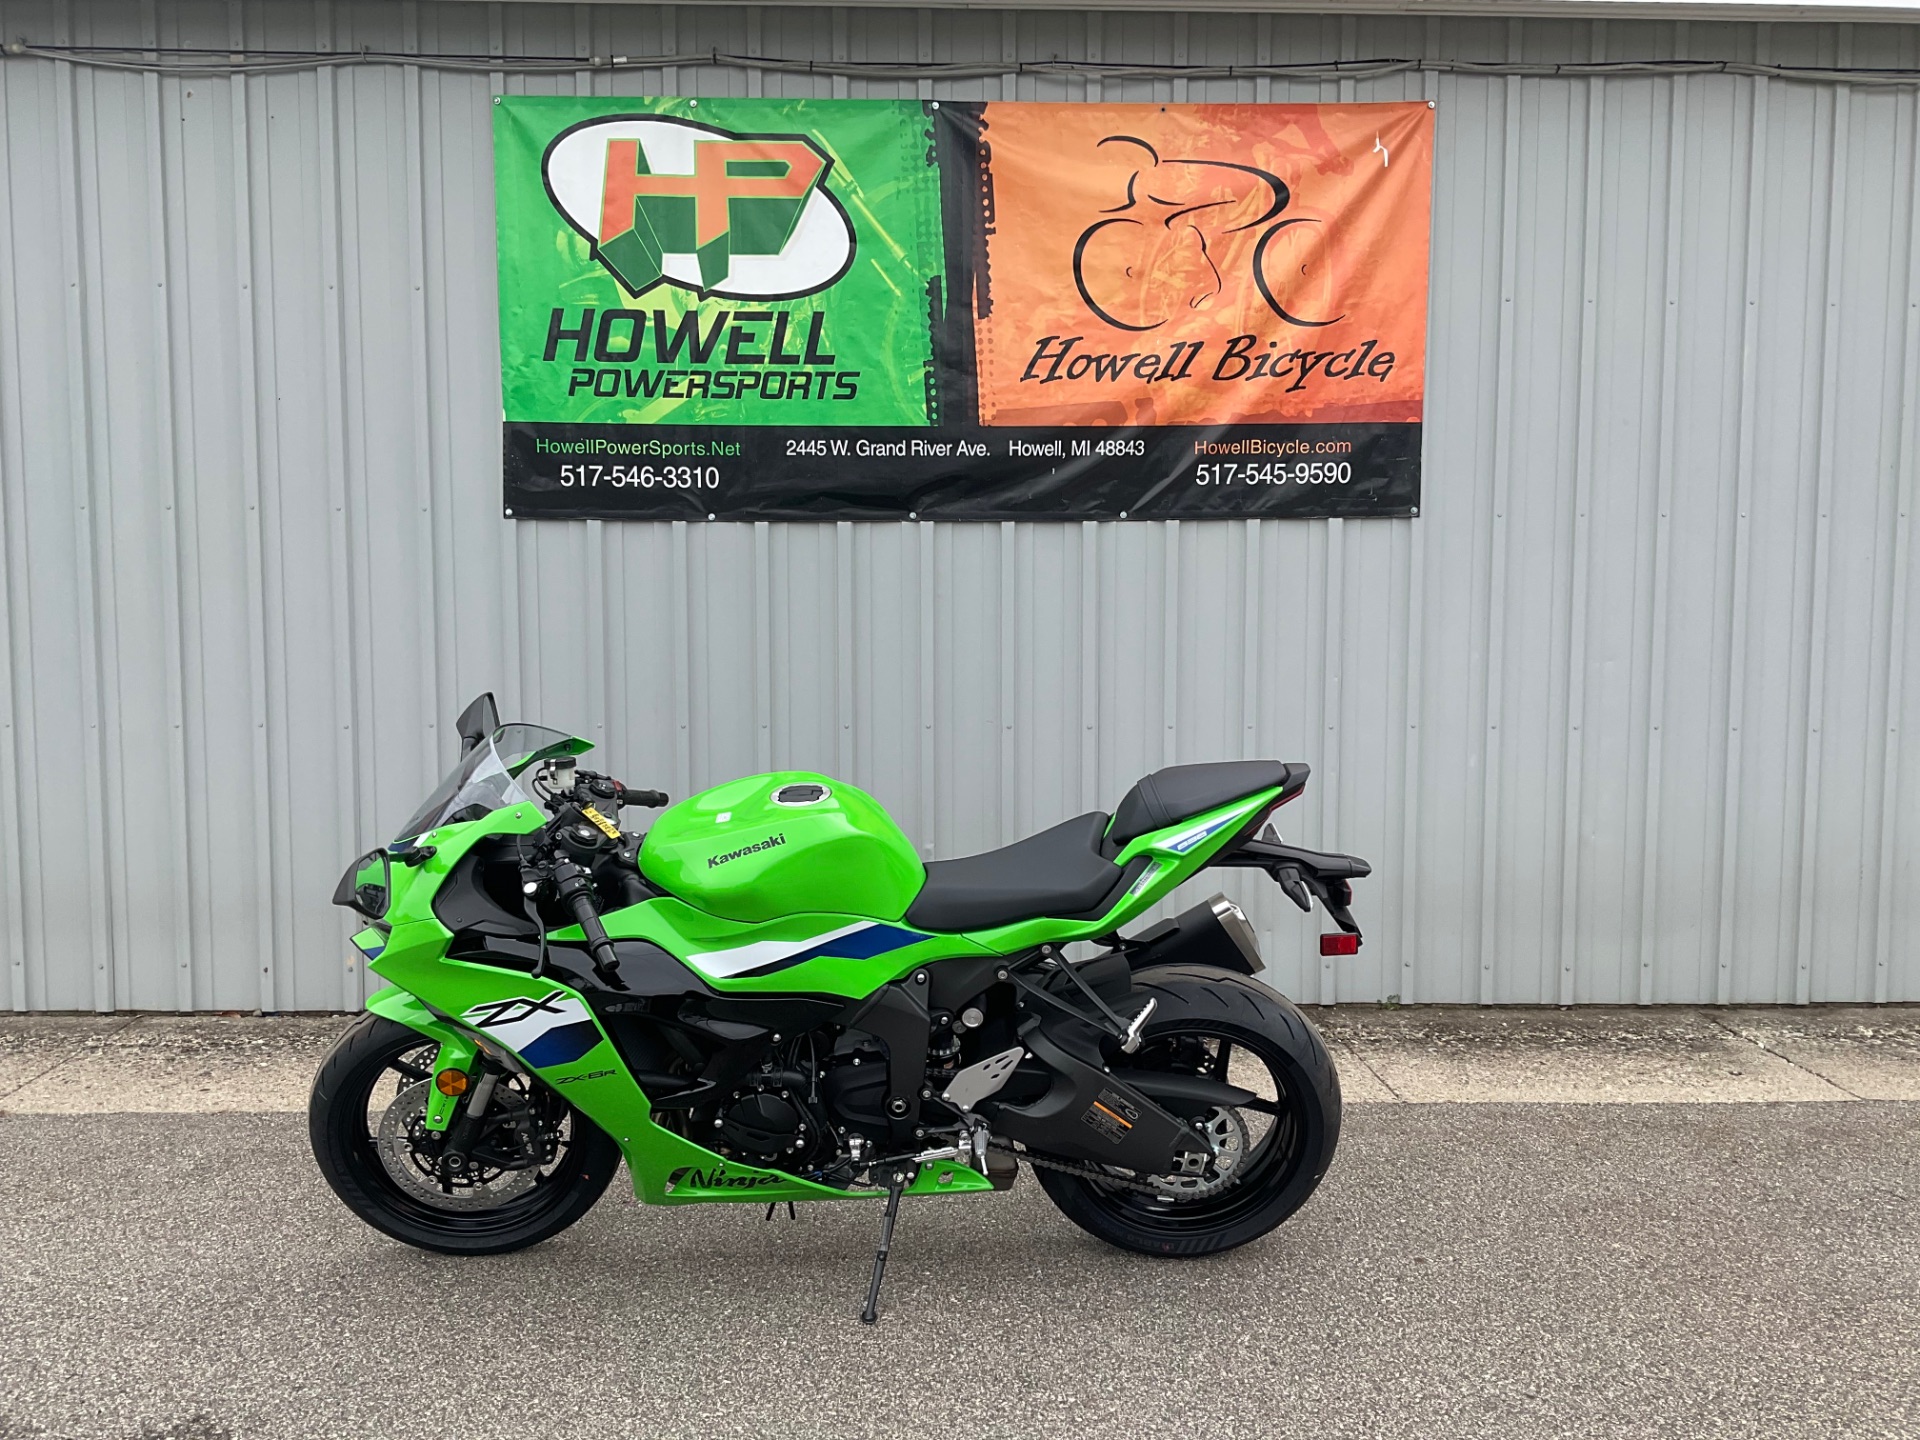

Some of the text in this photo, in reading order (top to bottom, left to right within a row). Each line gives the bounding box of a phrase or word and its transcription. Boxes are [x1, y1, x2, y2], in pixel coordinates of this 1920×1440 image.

[597, 138, 826, 250] HP
[542, 307, 836, 365] HOWELL
[1020, 334, 1396, 393] Howell Bicycle
[568, 368, 861, 400] POWERSPORTS
[535, 438, 741, 459] HowellPowerSports.Net
[786, 439, 1145, 459] 2445 W. Grand River Ave. Howell, MI 48843
[1194, 439, 1352, 458] HowellBicycle.com
[560, 464, 720, 489] 517-546-3310
[1195, 462, 1352, 486] 517-545-9590
[707, 833, 786, 869] Kawasaki
[468, 990, 567, 1028] ZX
[555, 1069, 617, 1085] ZX-6R
[690, 1168, 784, 1189] Ninja
